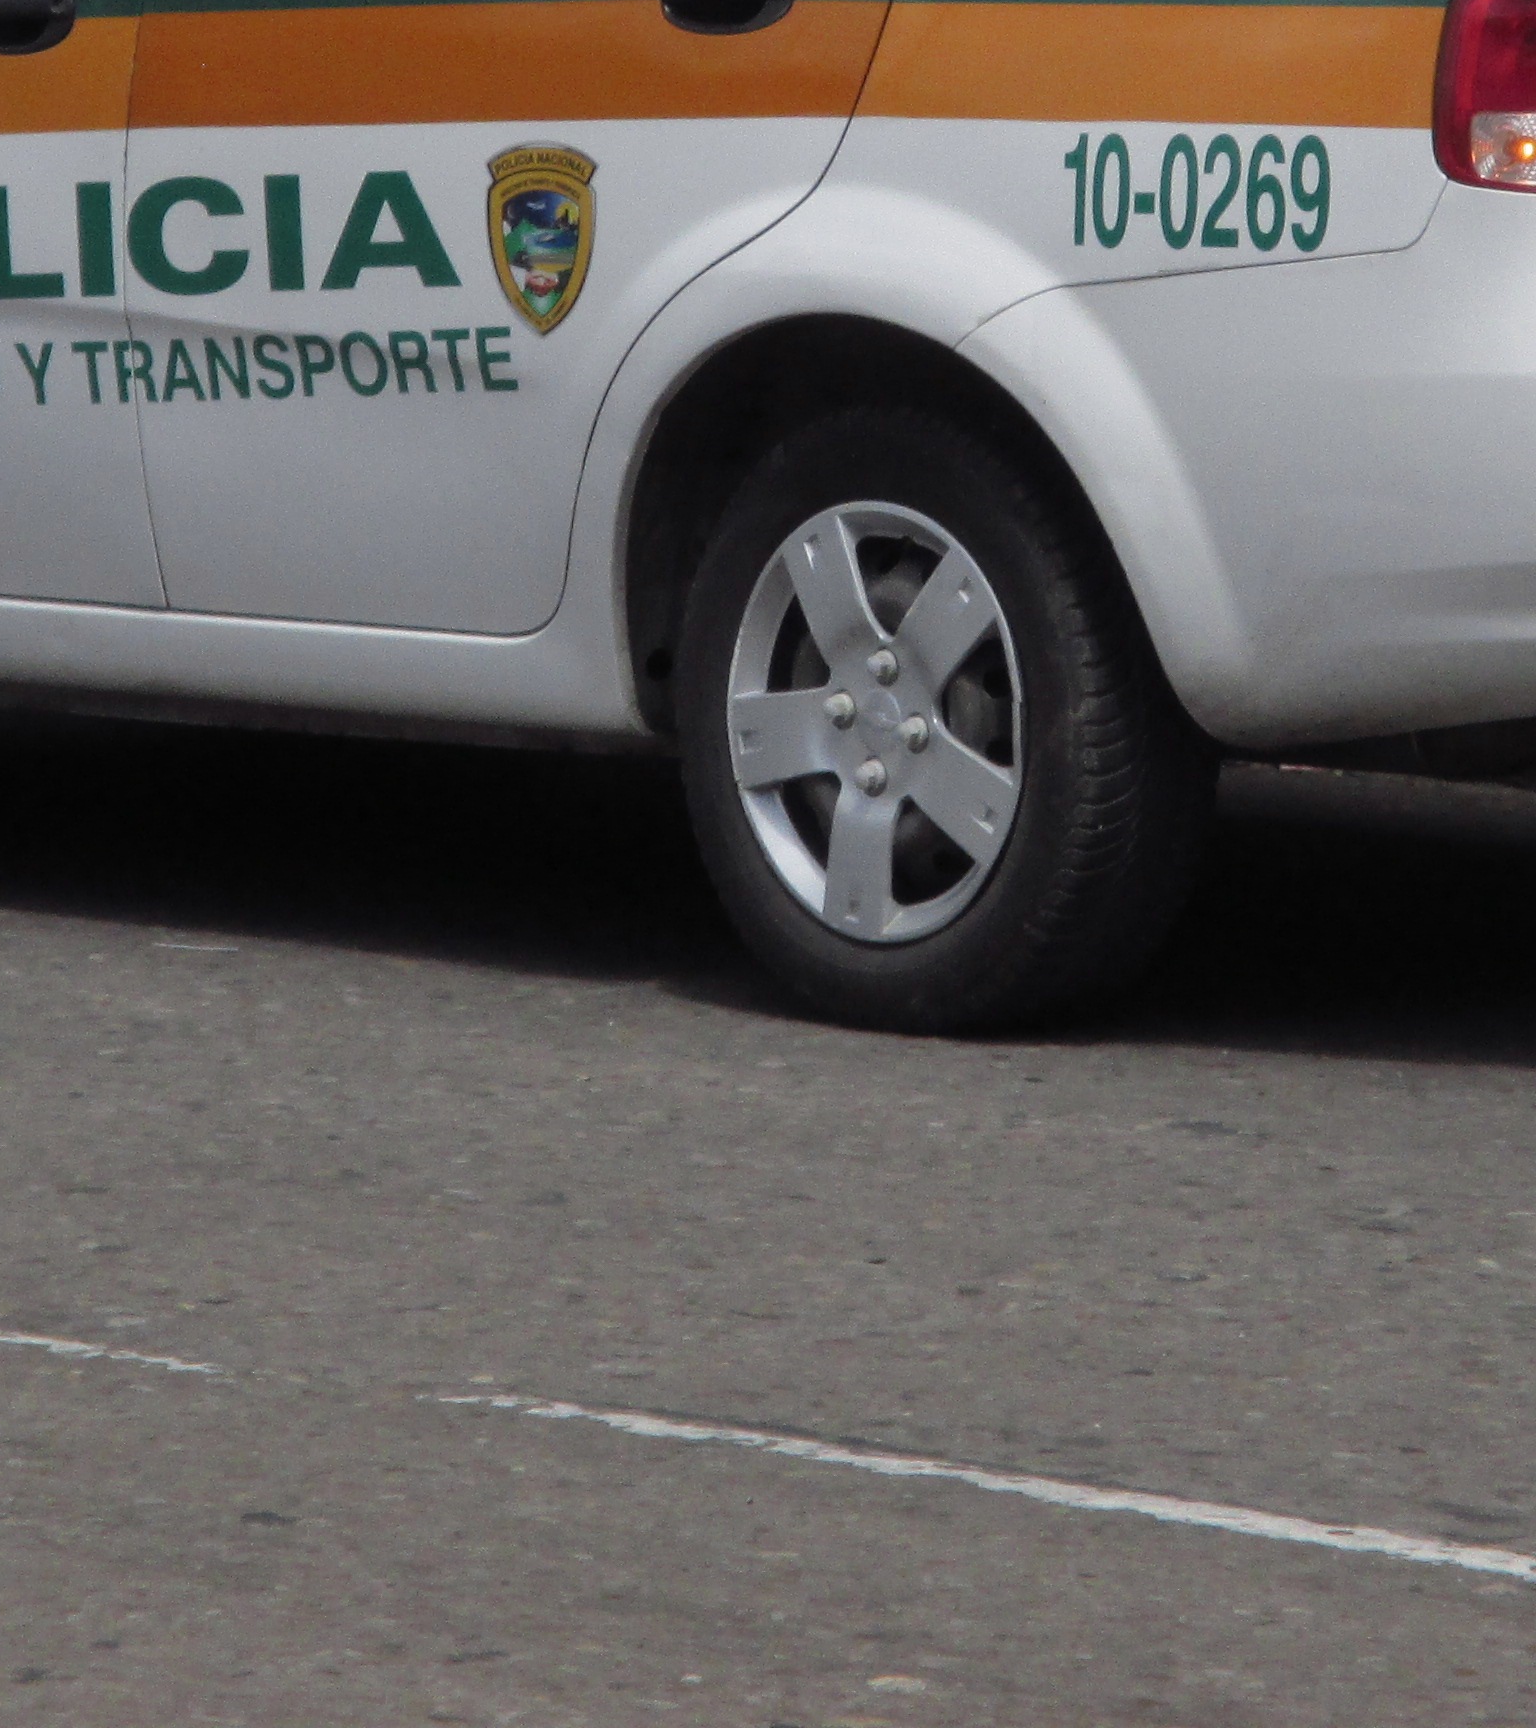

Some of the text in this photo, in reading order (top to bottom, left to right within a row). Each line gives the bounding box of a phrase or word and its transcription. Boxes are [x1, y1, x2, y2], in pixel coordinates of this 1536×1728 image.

[1064, 132, 1331, 253] 10-0269
[15, 342, 53, 406] Y
[71, 325, 520, 405] TRANSPORTE
